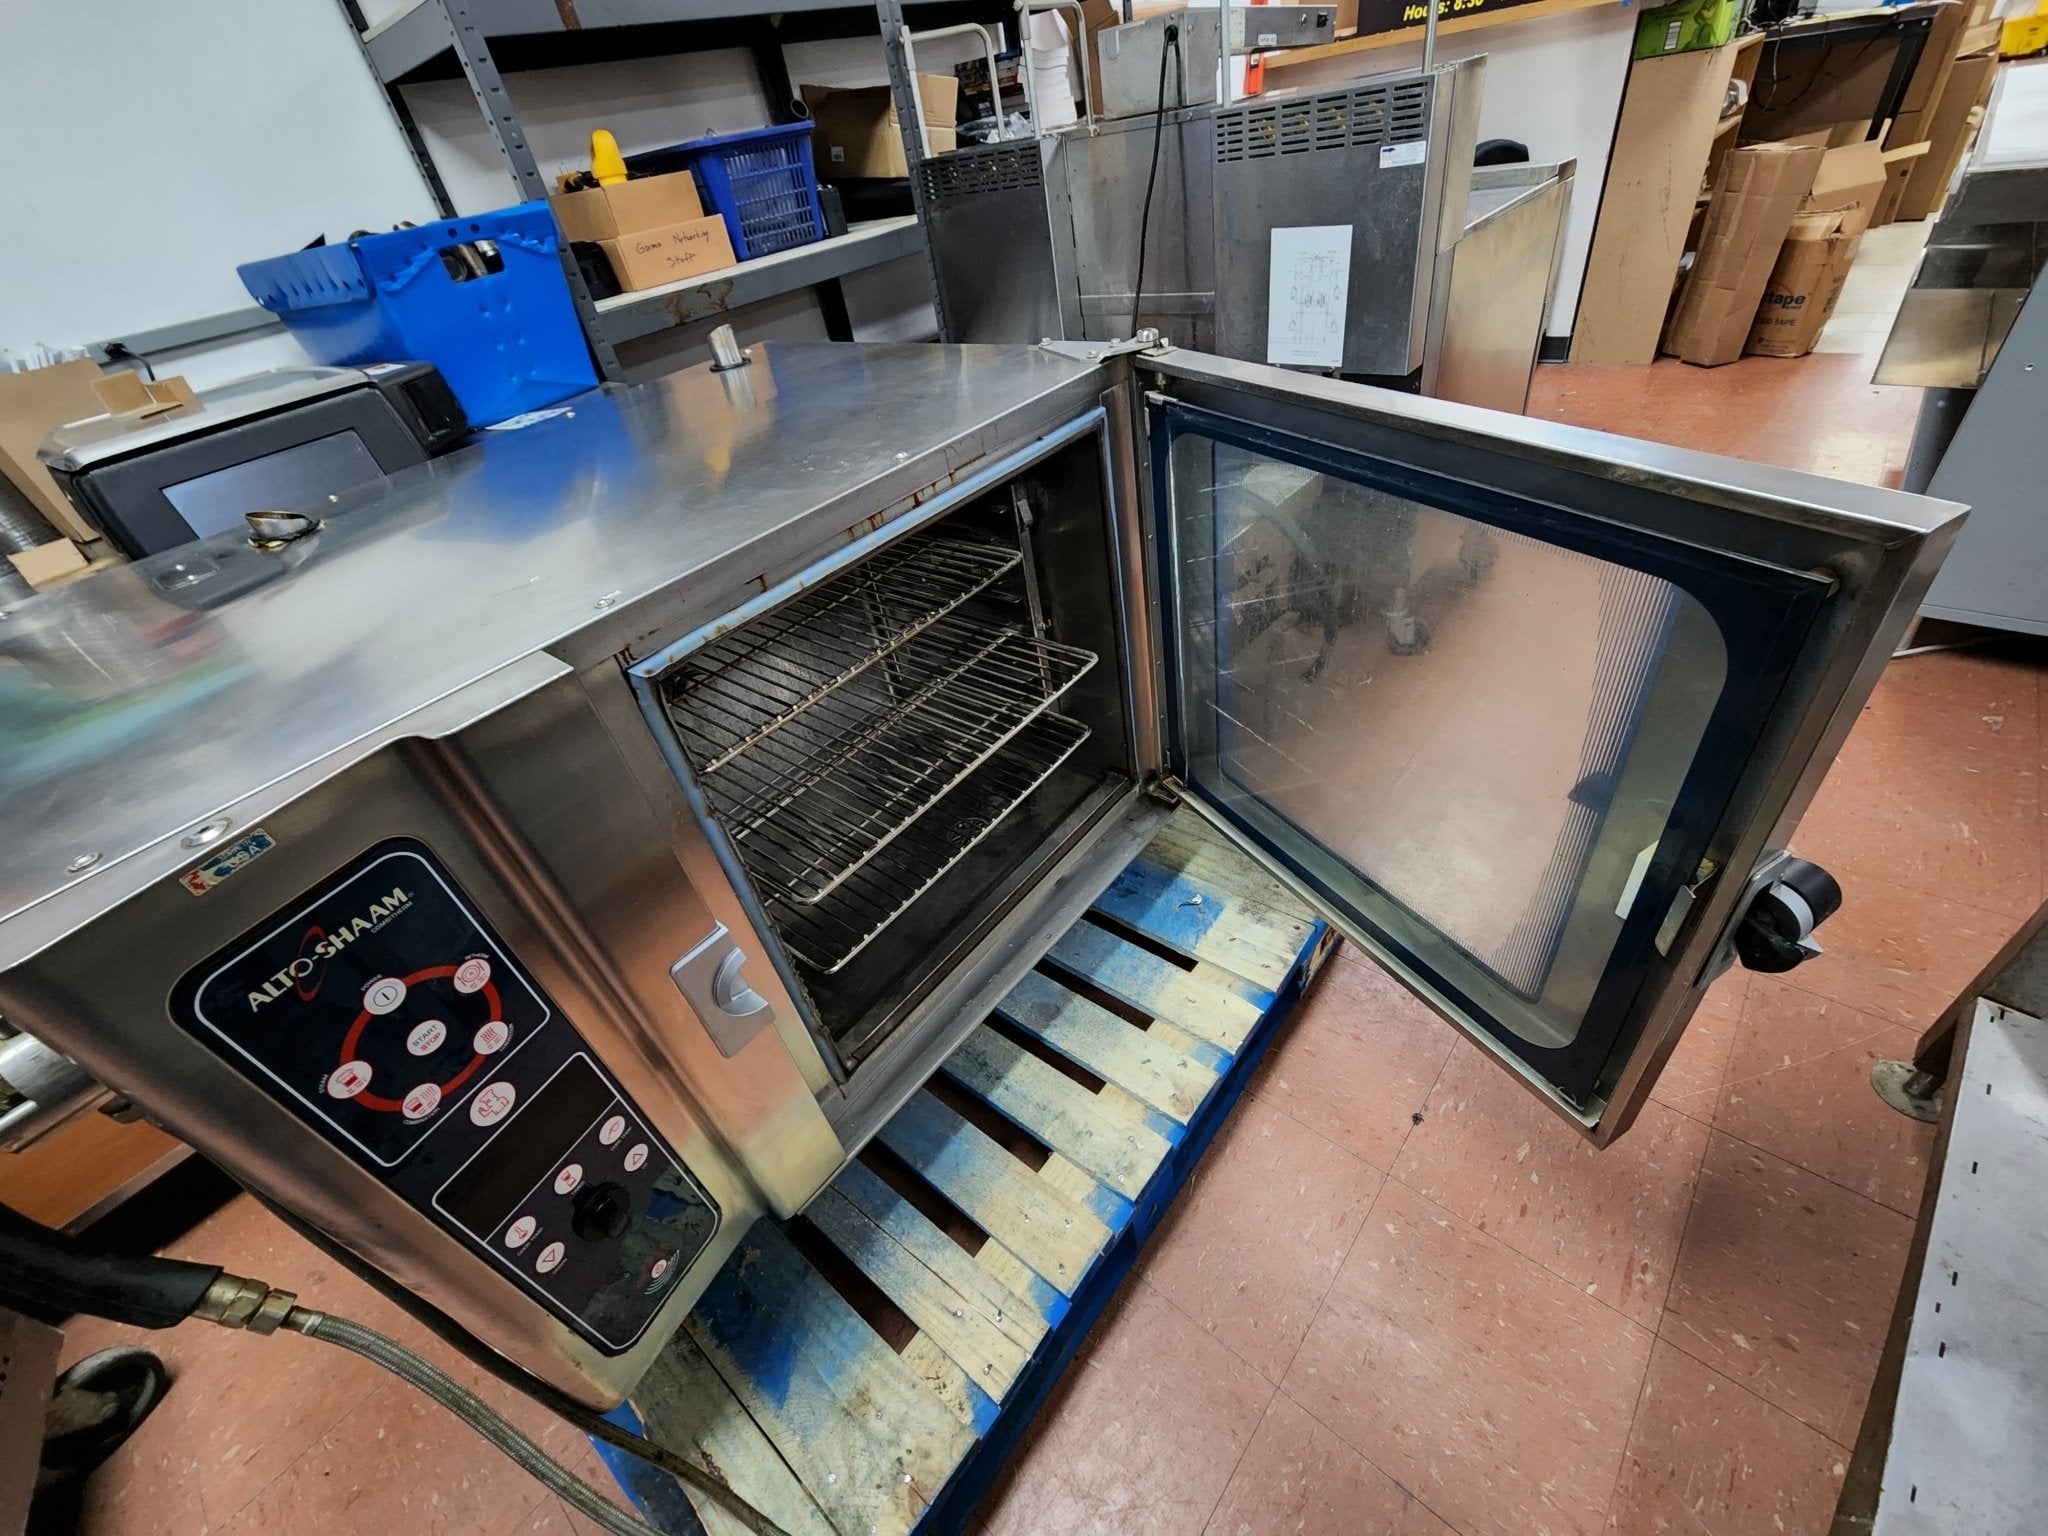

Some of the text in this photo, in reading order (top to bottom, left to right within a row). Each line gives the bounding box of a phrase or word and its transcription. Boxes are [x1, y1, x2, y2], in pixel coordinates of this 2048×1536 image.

[1403, 1, 1450, 20] Hous:
[371, 901, 414, 934] COMBITHERM
[248, 887, 409, 1013] ALTO-SHAAM
[361, 974, 382, 992] POWER
[412, 1024, 438, 1047] START
[420, 1032, 441, 1051] STOP
